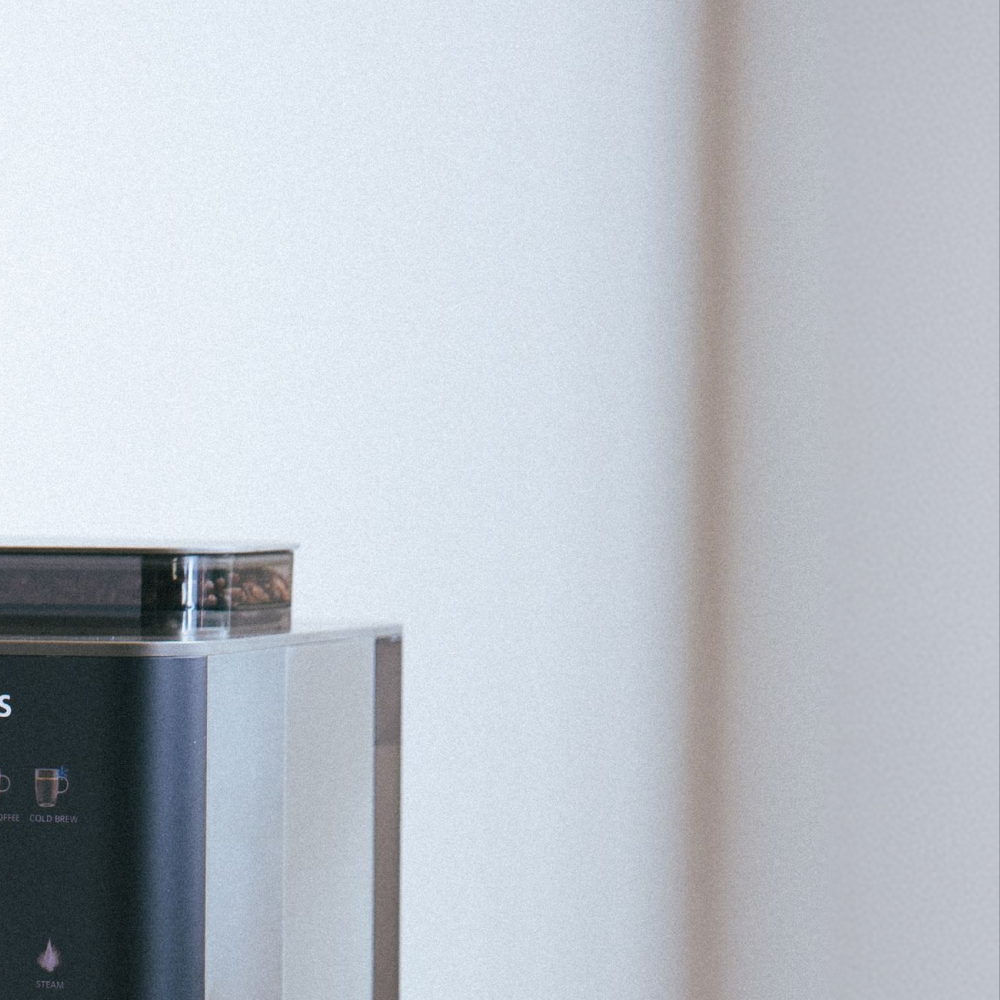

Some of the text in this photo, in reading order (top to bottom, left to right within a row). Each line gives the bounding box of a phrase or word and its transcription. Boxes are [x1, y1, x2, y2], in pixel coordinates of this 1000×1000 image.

[29, 813, 79, 823] COLD BREW
[36, 980, 65, 989] STEAM
